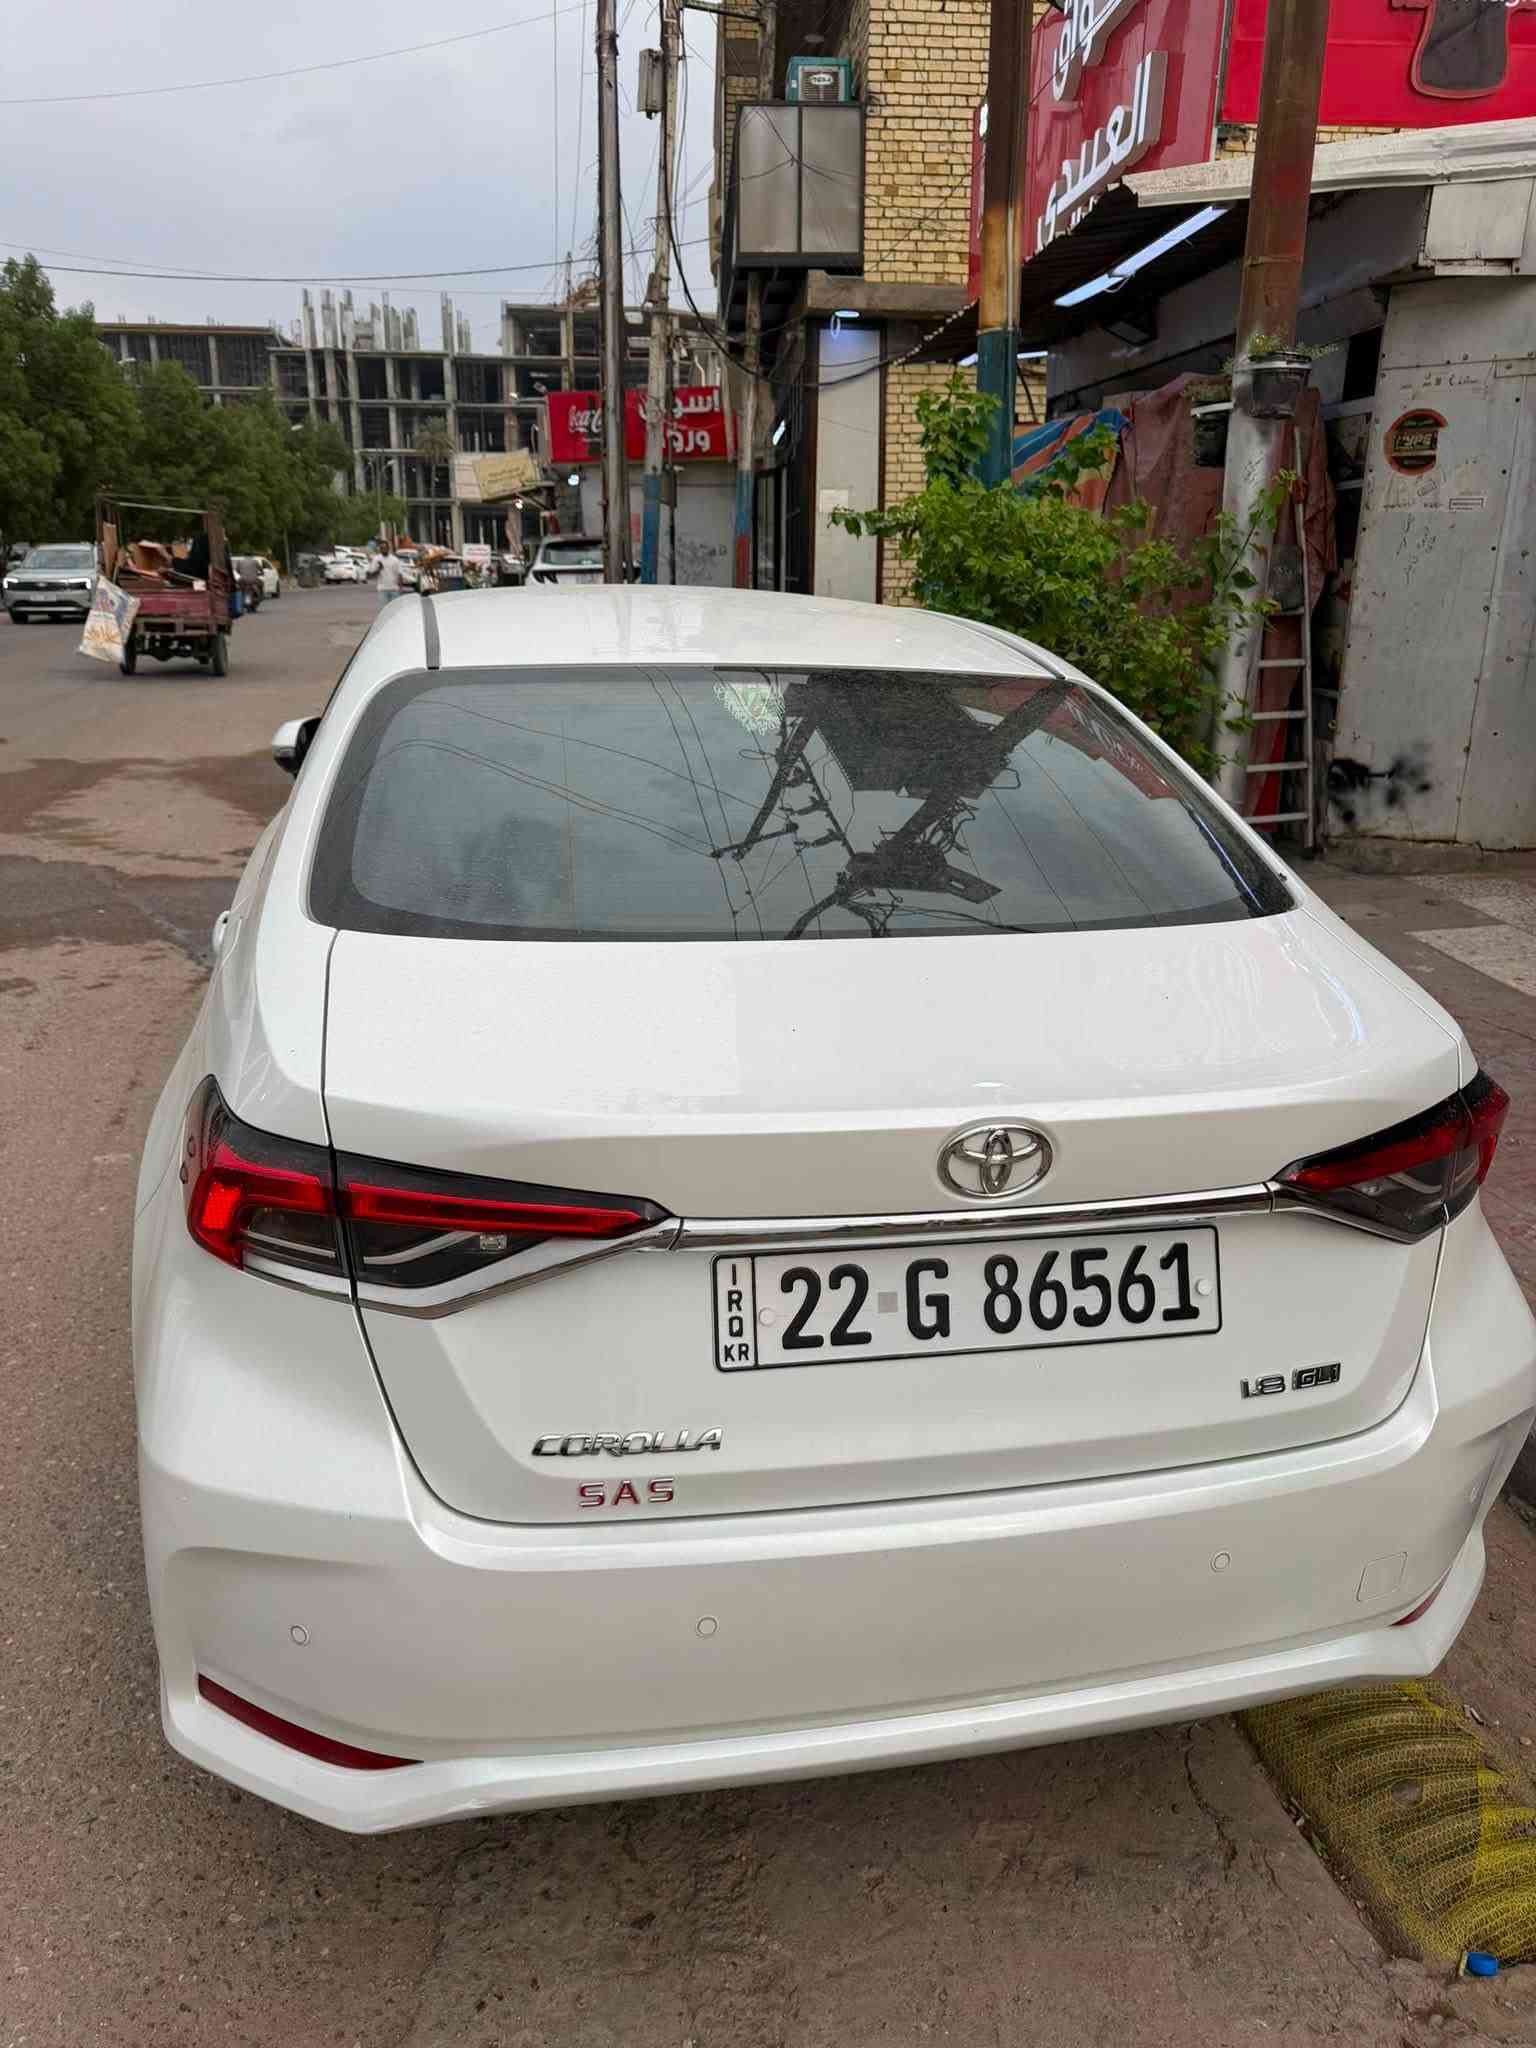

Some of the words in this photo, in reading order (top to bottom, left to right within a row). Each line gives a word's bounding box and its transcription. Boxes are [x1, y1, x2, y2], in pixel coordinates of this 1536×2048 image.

[779, 1264, 873, 1351] 22
[905, 1257, 951, 1341] G
[982, 1242, 1201, 1335] 86561
[724, 1343, 750, 1363] KR
[531, 1425, 724, 1458] COROLLA
[578, 1477, 675, 1508] SAS
